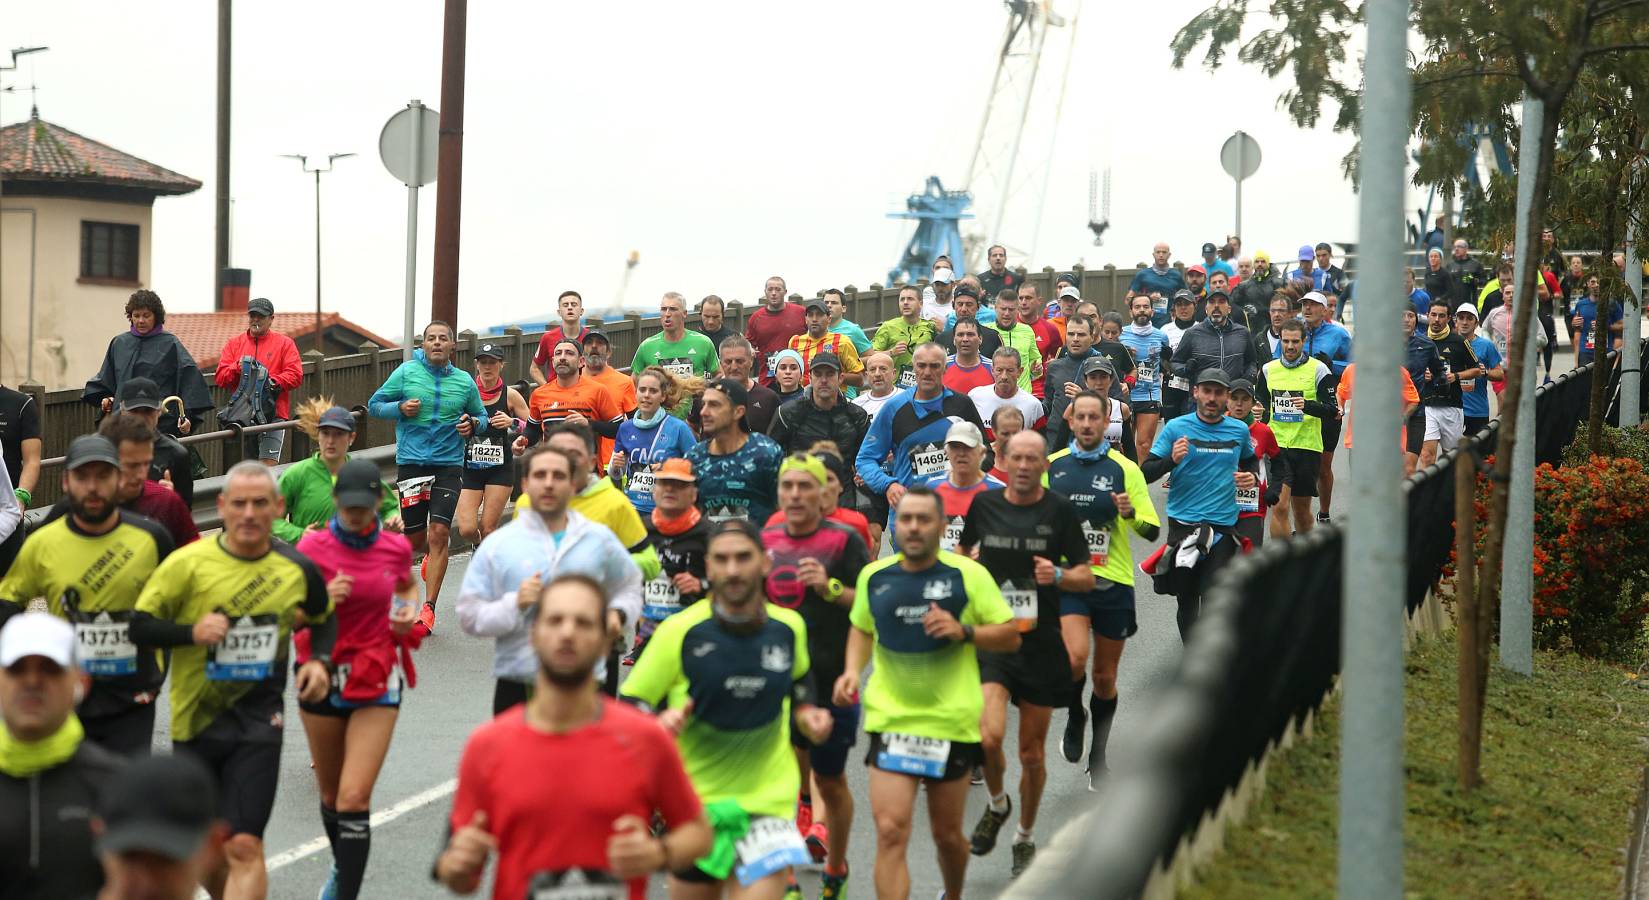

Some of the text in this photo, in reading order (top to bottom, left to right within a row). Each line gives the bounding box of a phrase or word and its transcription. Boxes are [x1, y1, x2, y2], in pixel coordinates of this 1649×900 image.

[1276, 399, 1294, 408] 1487
[473, 447, 501, 456] 18275
[634, 475, 656, 486] 1439
[1236, 490, 1256, 499] 928
[648, 582, 676, 596] 1374
